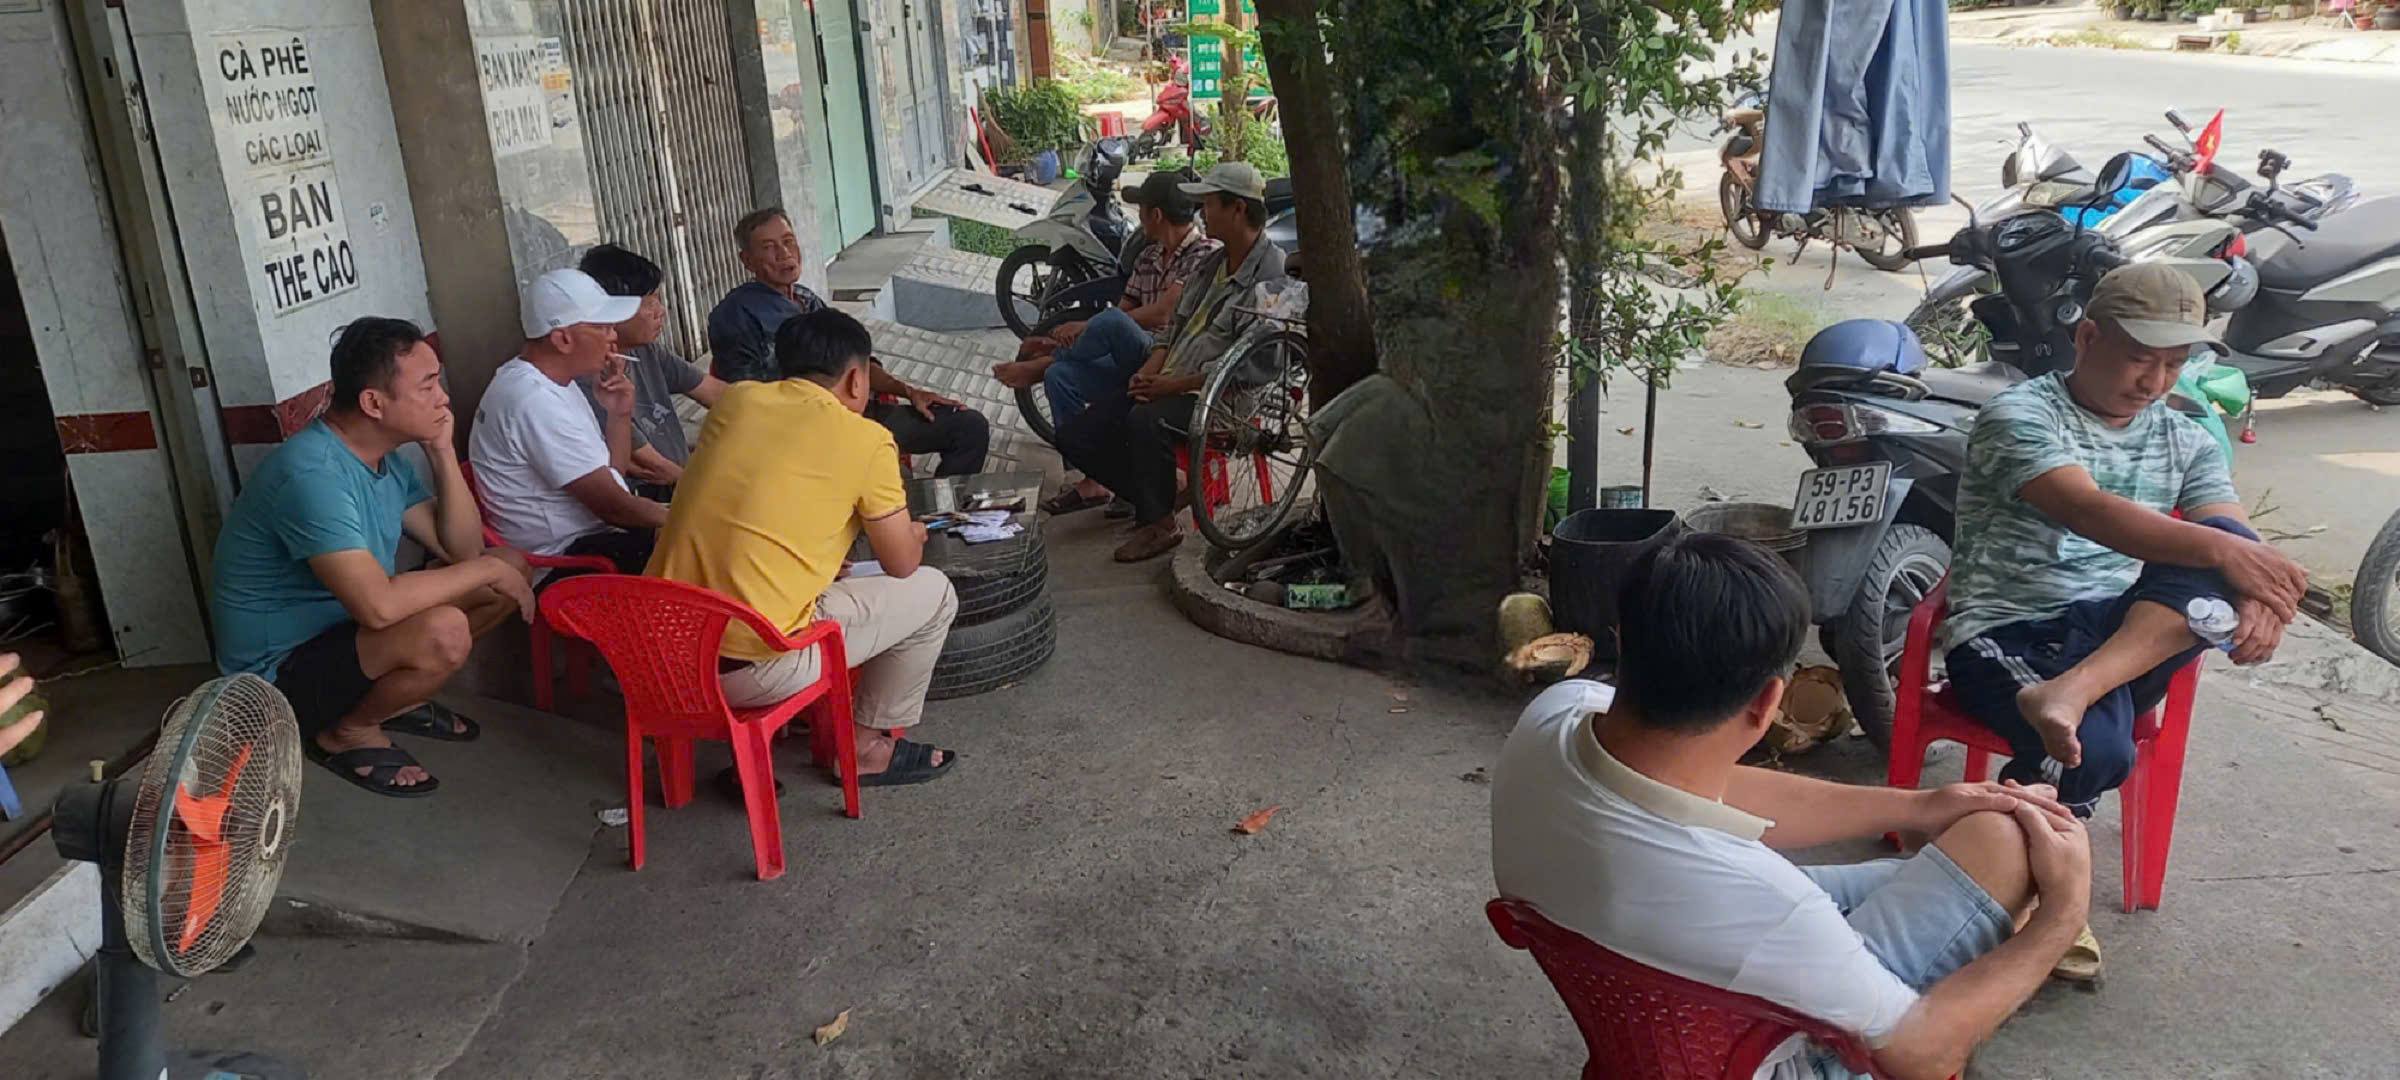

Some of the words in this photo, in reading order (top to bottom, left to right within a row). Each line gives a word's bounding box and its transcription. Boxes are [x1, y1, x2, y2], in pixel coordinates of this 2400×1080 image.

[219, 40, 257, 81] CÀ
[260, 37, 309, 77] PHÊ
[480, 42, 512, 91] BÁN
[225, 84, 276, 124] NƯỚC
[275, 86, 318, 120] NGỌT
[245, 132, 282, 165] CÁC
[283, 129, 322, 160] LOẠI
[260, 173, 334, 240] BÁN
[264, 235, 313, 310] THẺ
[312, 232, 356, 294] CÀO
[1811, 467, 1875, 498] 59-P3
[1799, 495, 1876, 525] 481.56
